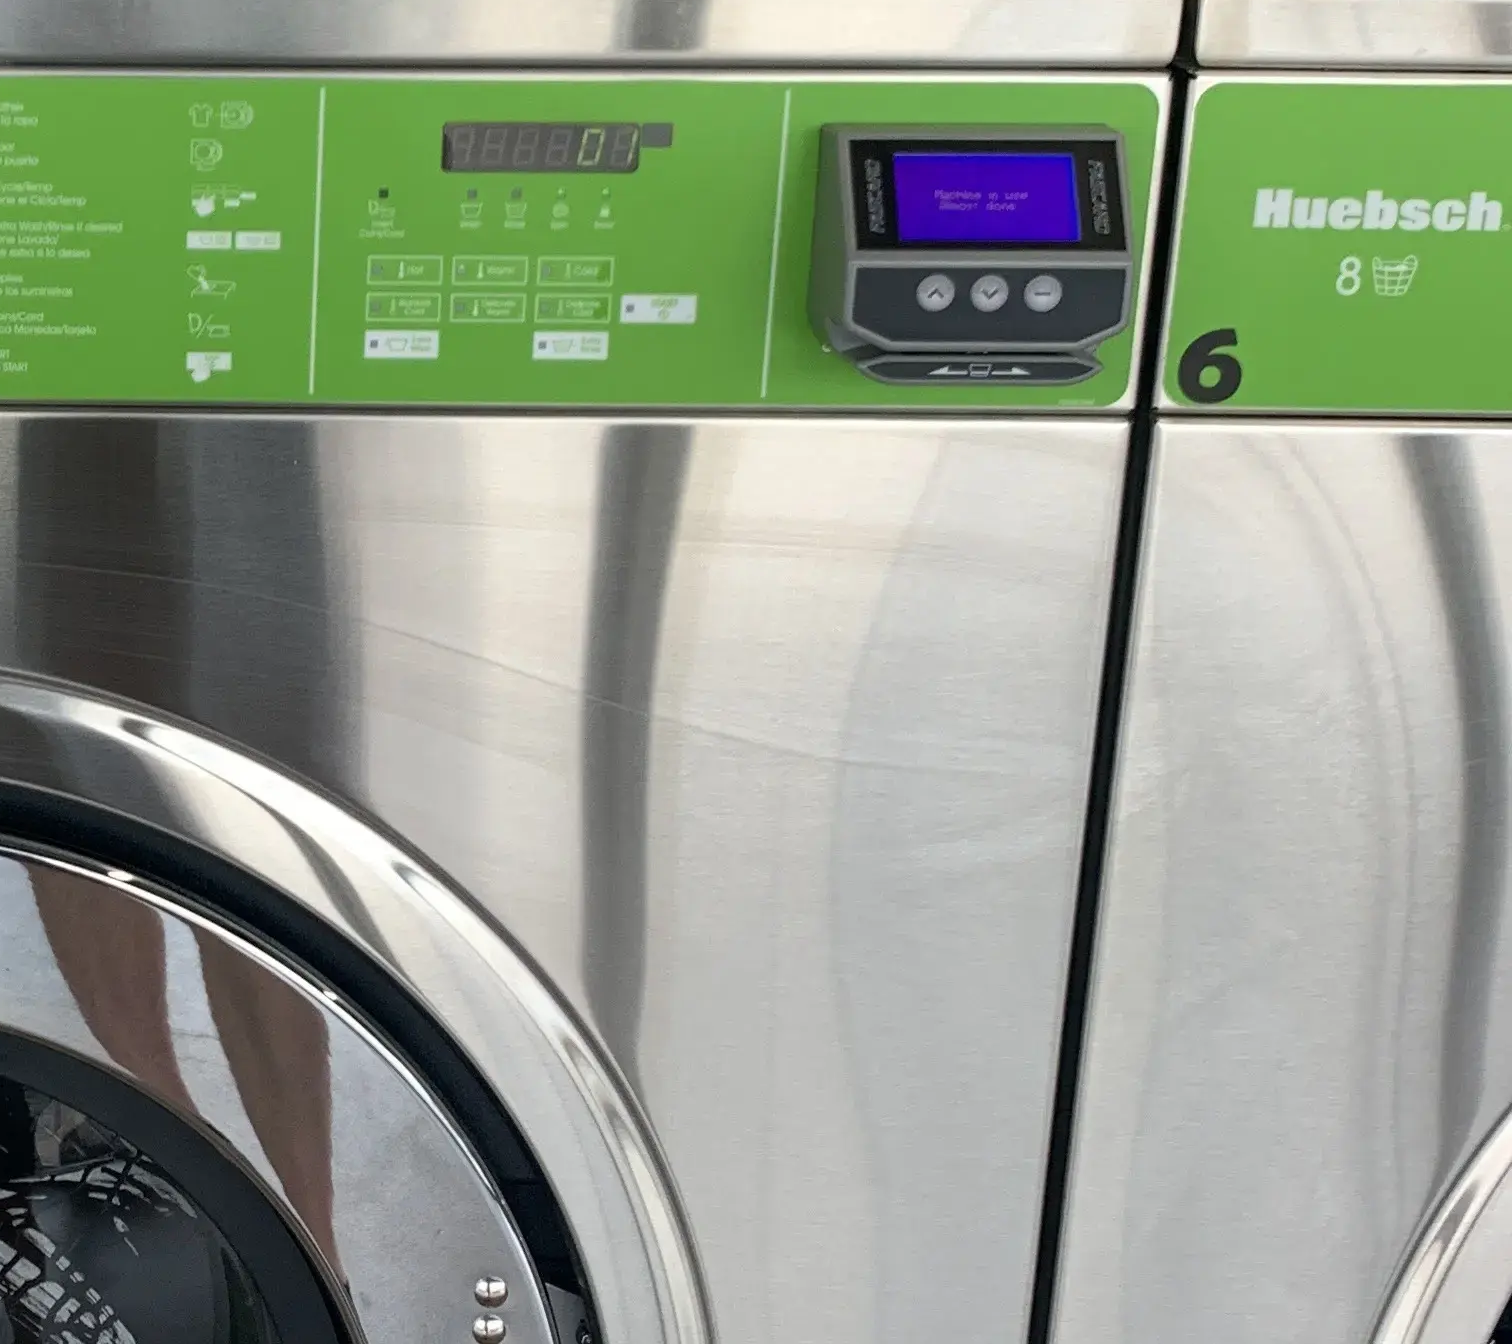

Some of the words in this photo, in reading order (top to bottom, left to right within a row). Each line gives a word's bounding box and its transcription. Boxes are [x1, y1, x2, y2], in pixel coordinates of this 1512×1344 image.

[1252, 188, 1504, 231] Huebsch
[1335, 256, 1362, 296] 8
[1177, 328, 1242, 404] 6
